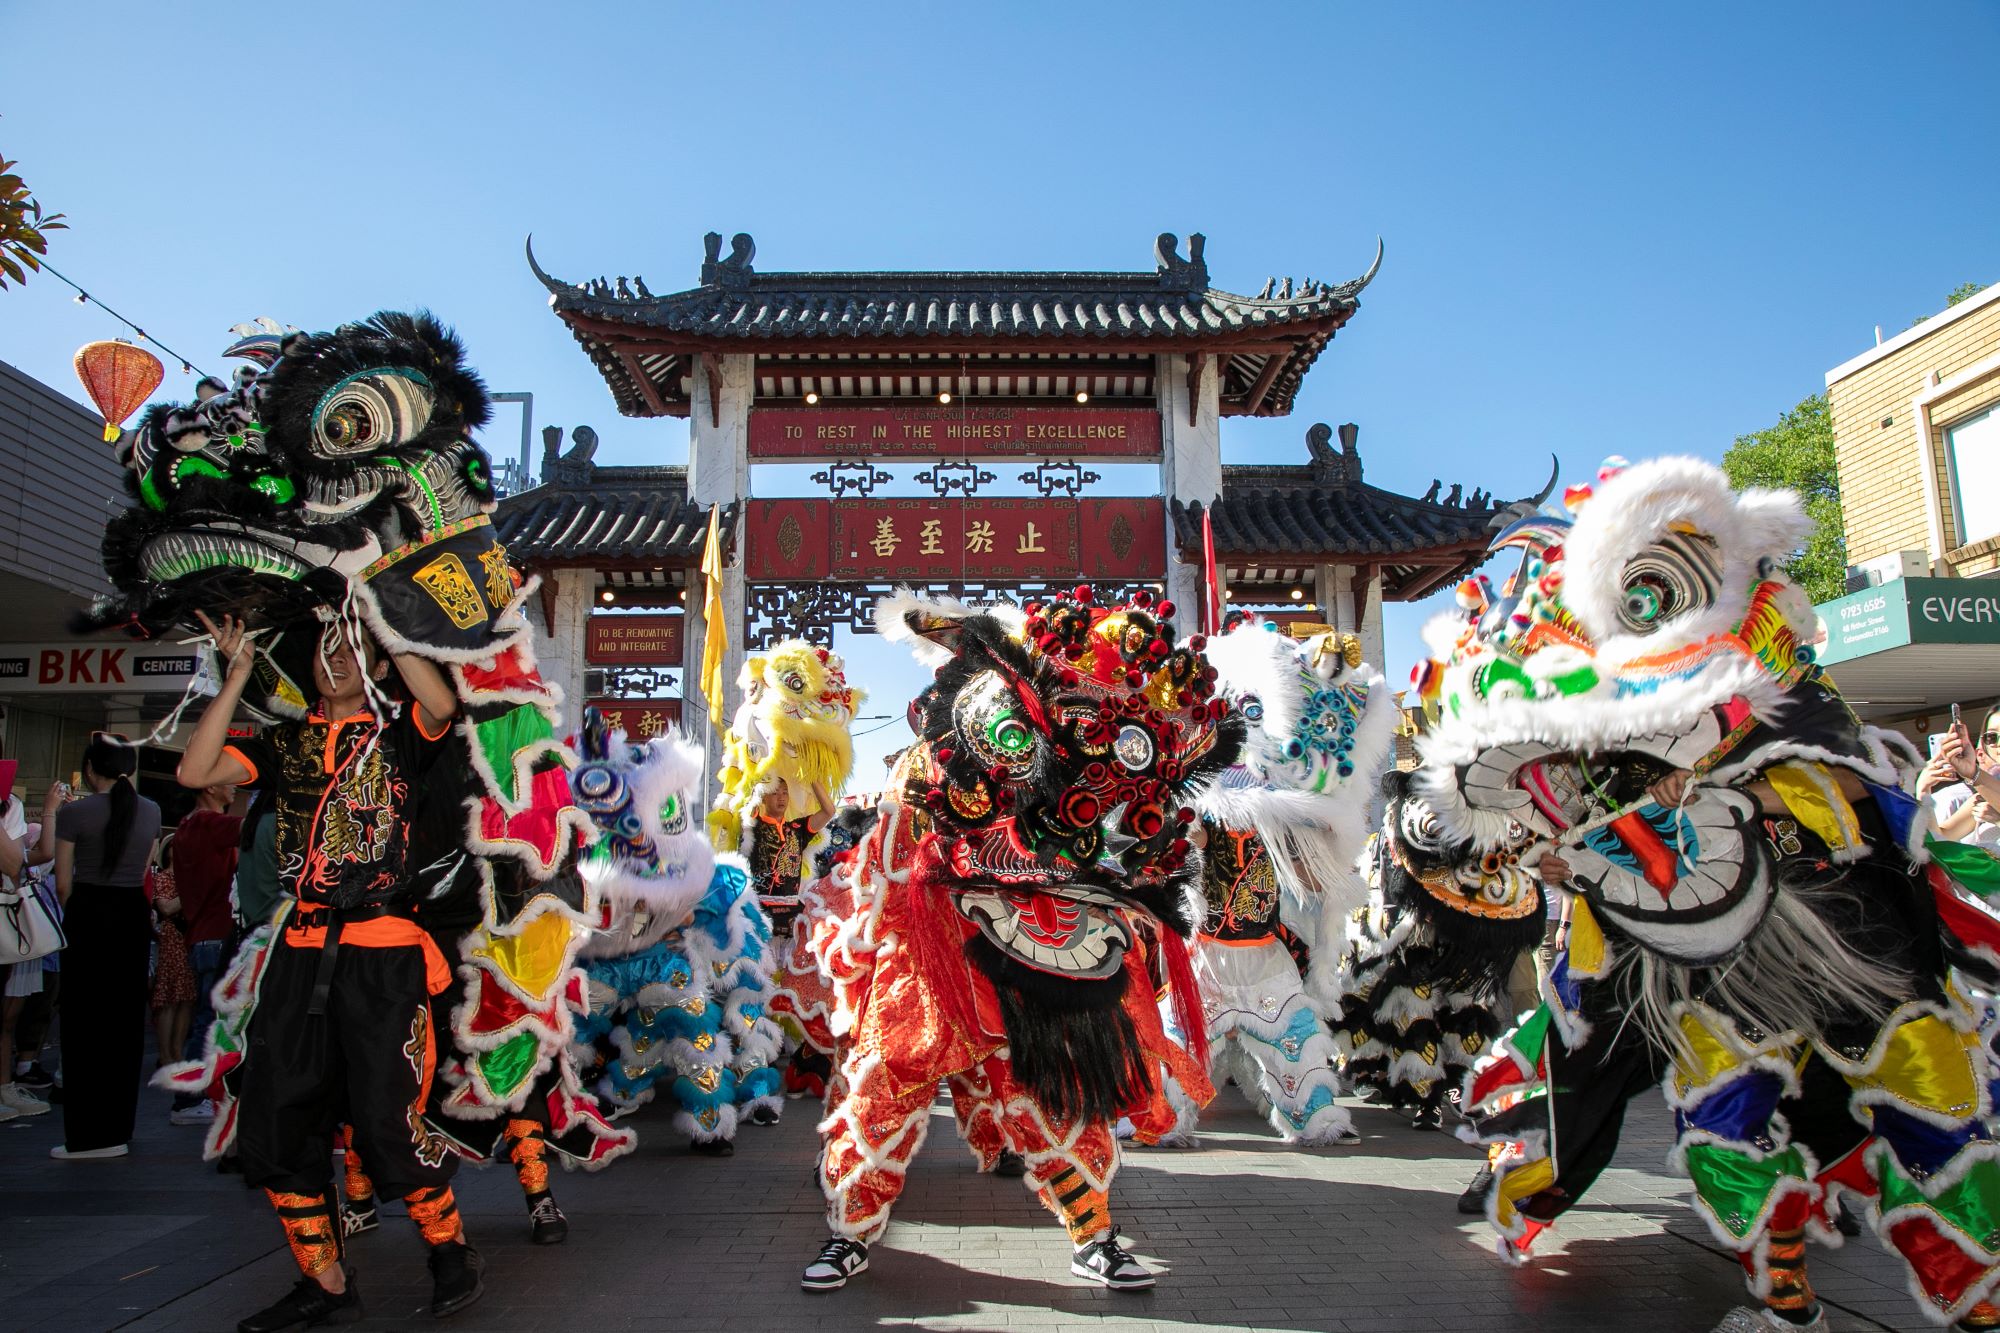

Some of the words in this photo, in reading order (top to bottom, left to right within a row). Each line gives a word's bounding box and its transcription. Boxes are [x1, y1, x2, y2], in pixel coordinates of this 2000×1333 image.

[785, 425, 803, 438] TO
[817, 425, 857, 438] REST
[872, 425, 887, 438] IN
[903, 425, 932, 438] THE
[947, 424, 1012, 438] HIGHEST
[1027, 424, 1127, 439] EXCELLENCE
[1840, 604, 1862, 620] 9723
[1863, 596, 1886, 613] 6525
[1867, 616, 1885, 626] Street
[598, 628, 608, 638] TO
[612, 628, 623, 638] BE
[626, 628, 674, 638] RENOVATIVE
[598, 642, 616, 651] AND
[620, 641, 667, 651] INTEGRATE
[38, 648, 126, 684] BKK
[142, 659, 191, 673] CENTRE
